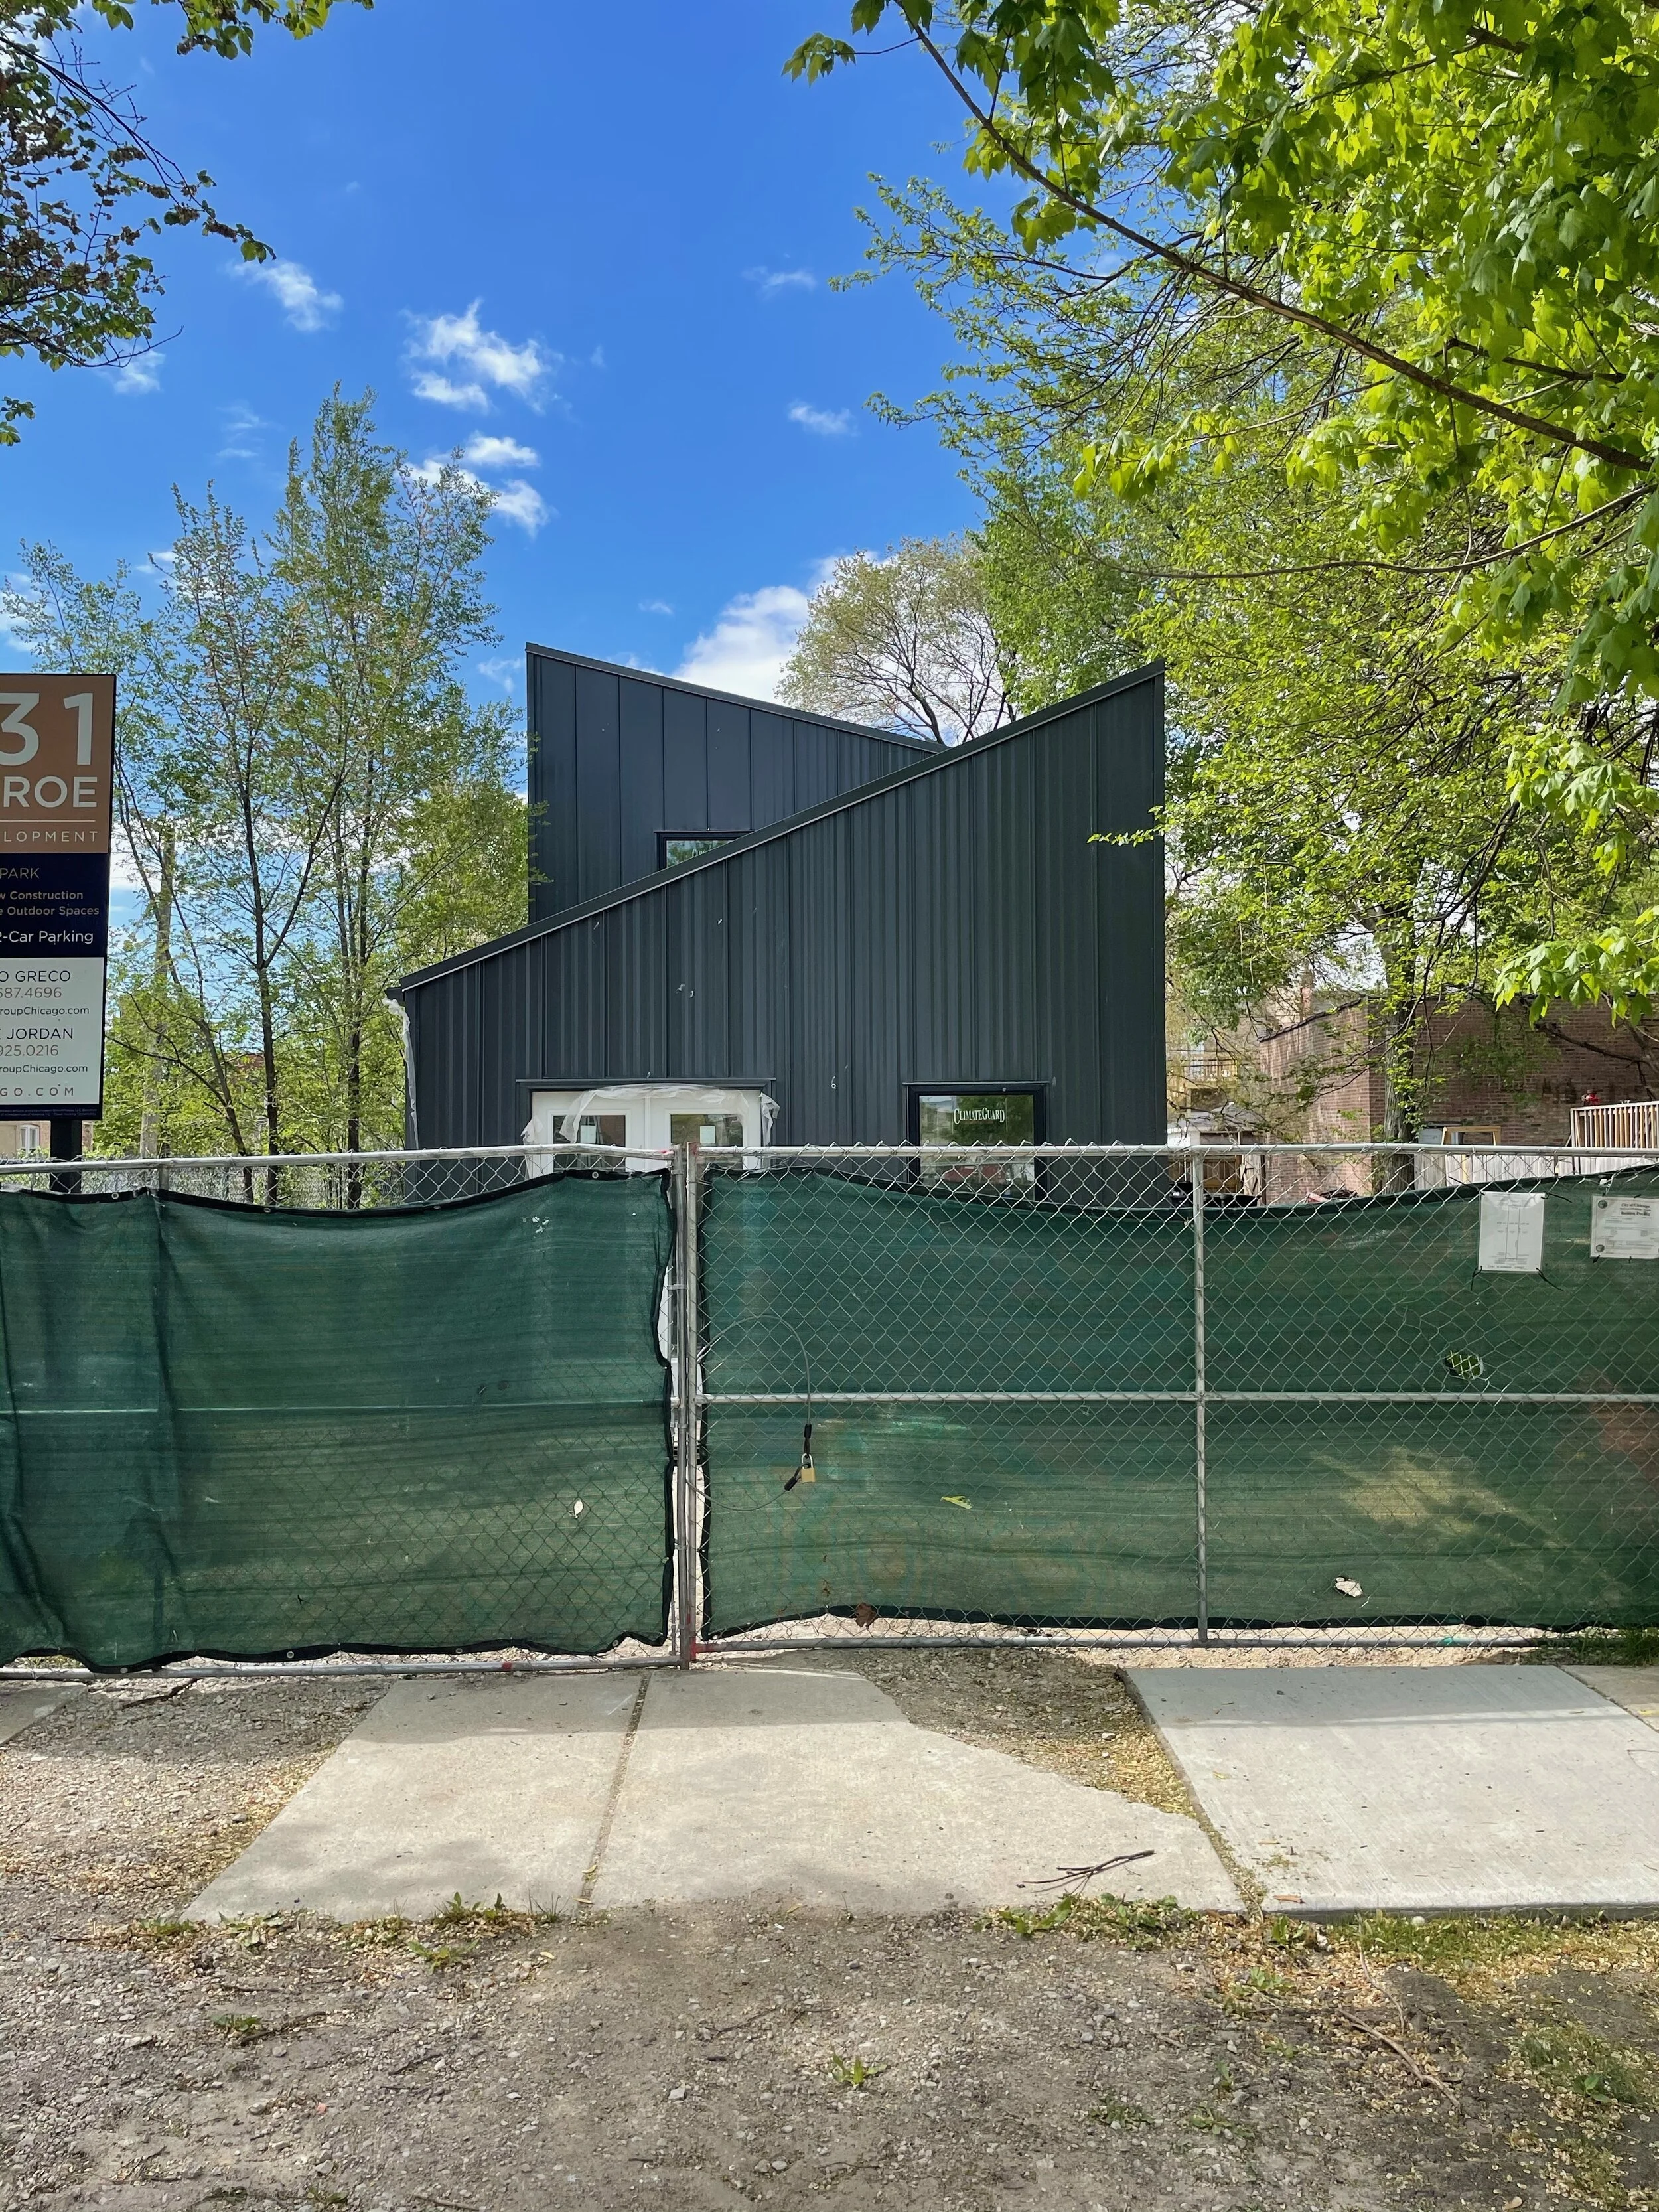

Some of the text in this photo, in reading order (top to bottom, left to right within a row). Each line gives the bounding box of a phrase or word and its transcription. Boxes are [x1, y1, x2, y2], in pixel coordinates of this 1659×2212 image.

[0, 693, 93, 766] 31
[3, 776, 98, 808] ROE
[4, 831, 98, 842] LOPMENT
[0, 868, 40, 879] PARK
[10, 891, 84, 900] Construction
[7, 906, 55, 915] Outdoor
[59, 907, 100, 917] Spaces
[0, 930, 94, 944] -Car Parking
[15, 970, 71, 982] GRECO
[7, 1028, 74, 1040] JORDAN
